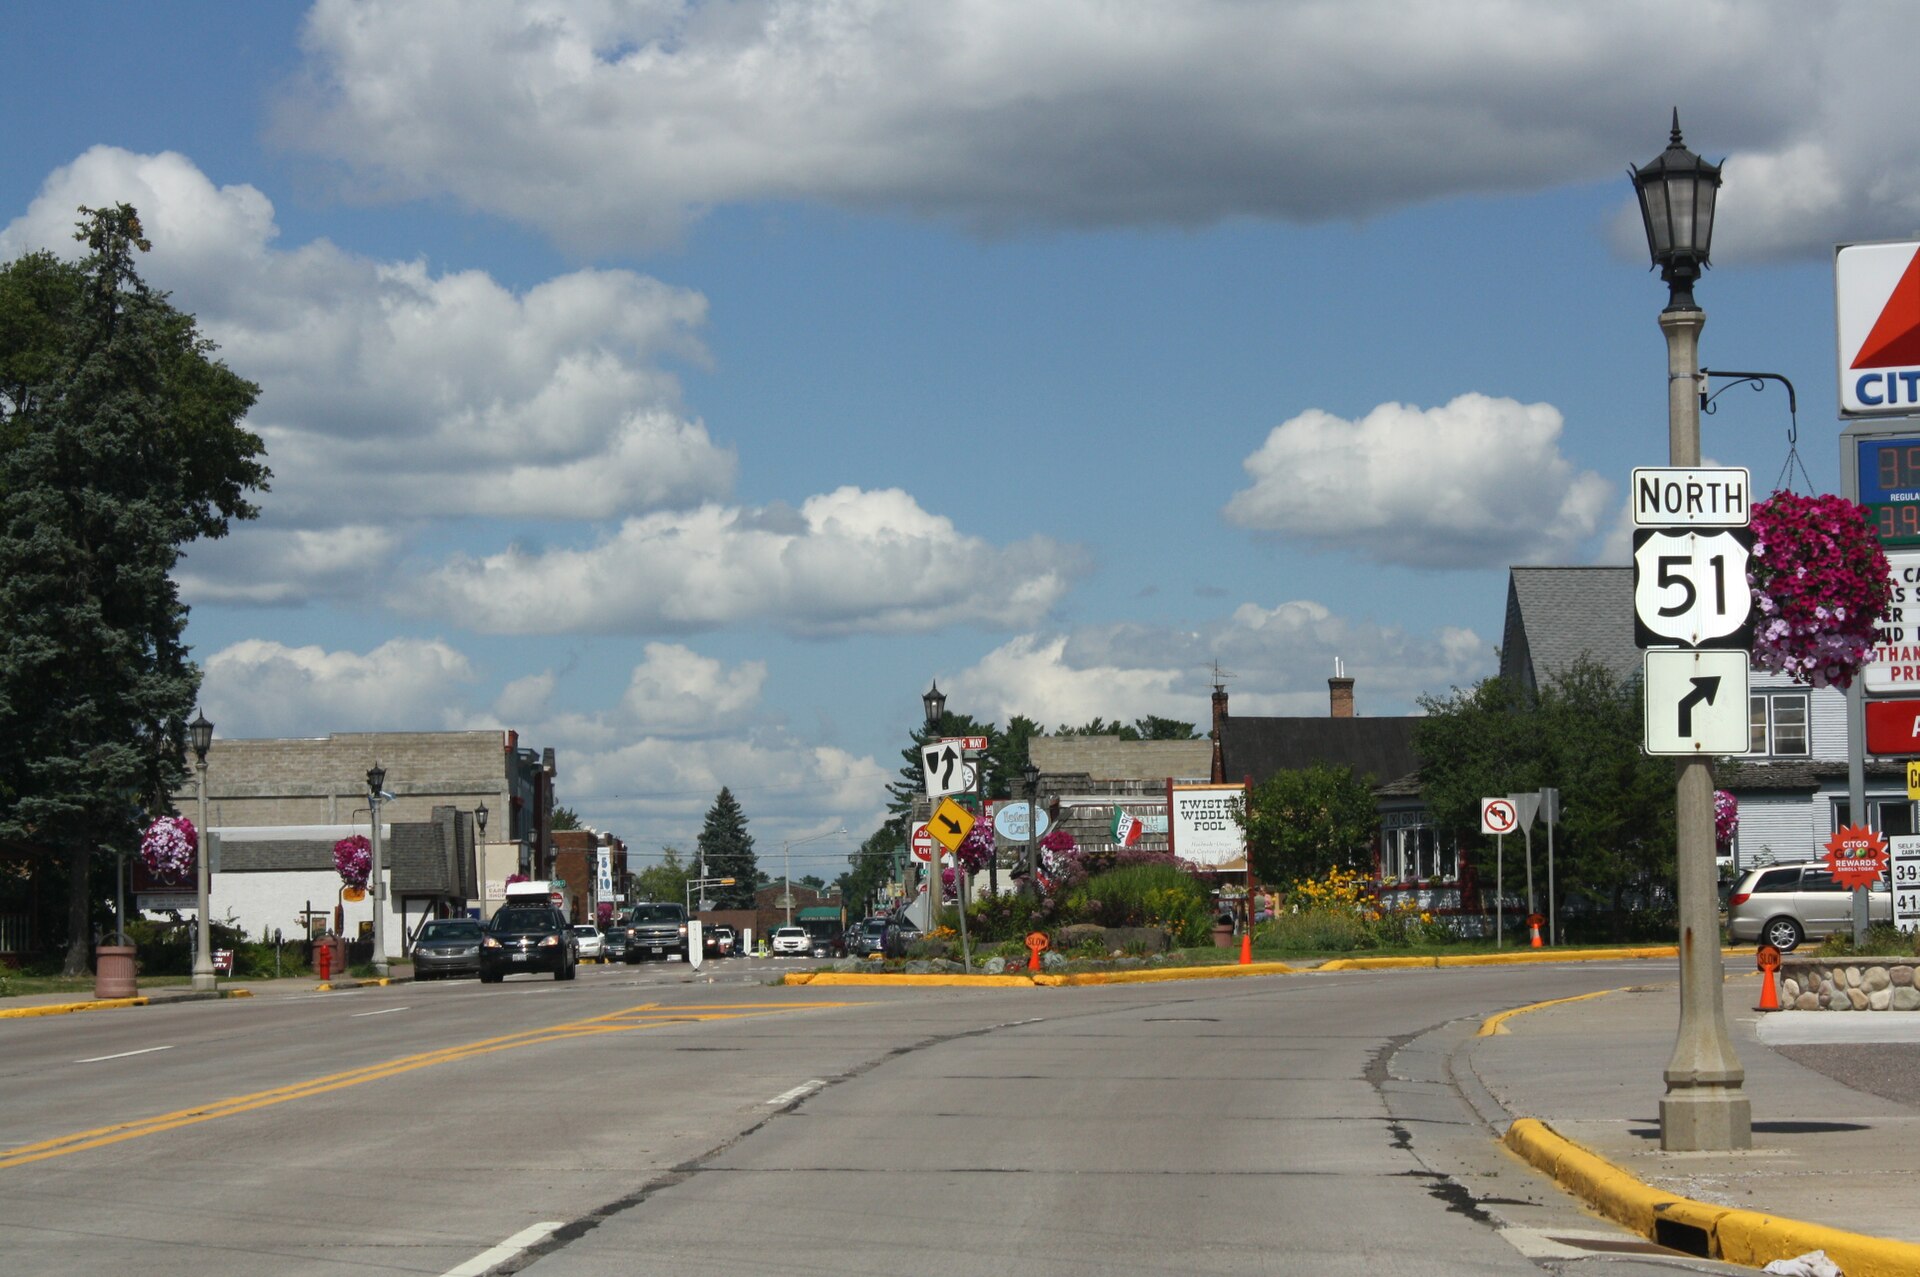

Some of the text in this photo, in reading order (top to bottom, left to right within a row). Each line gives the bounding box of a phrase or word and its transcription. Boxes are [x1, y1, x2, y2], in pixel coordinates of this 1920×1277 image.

[1855, 371, 1920, 406] CIT
[1640, 478, 1742, 513] NORTH
[1657, 555, 1726, 618] 51
[969, 738, 983, 748] WAY
[1008, 823, 1030, 835] Caf
[1194, 822, 1226, 831] FOOL
[918, 830, 929, 838] DO
[1842, 840, 1869, 848] CITGO
[1028, 937, 1046, 946] SLOW
[1760, 953, 1778, 965] SLOW
